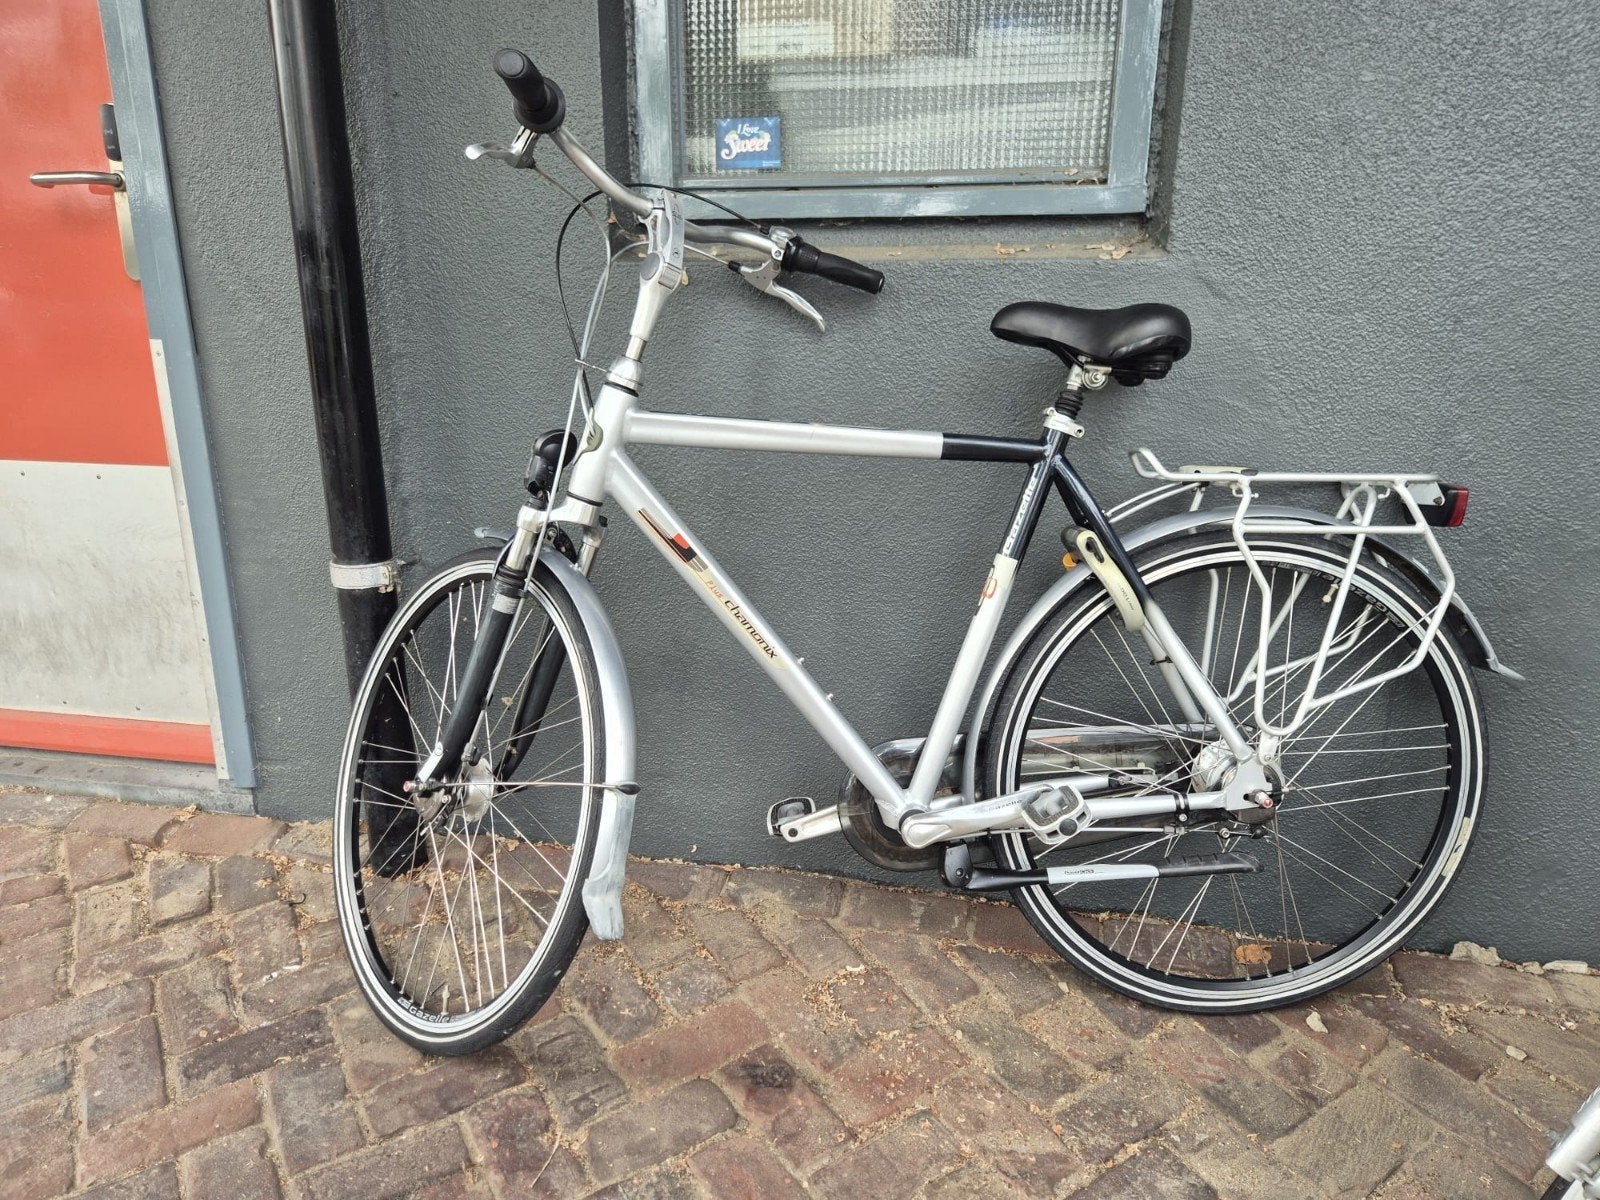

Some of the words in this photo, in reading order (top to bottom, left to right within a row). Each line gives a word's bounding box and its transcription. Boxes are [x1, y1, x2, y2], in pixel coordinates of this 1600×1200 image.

[737, 123, 742, 134] I
[741, 123, 760, 137] Love
[721, 130, 771, 160] Sweet
[408, 1005, 450, 1023] Gazelle
